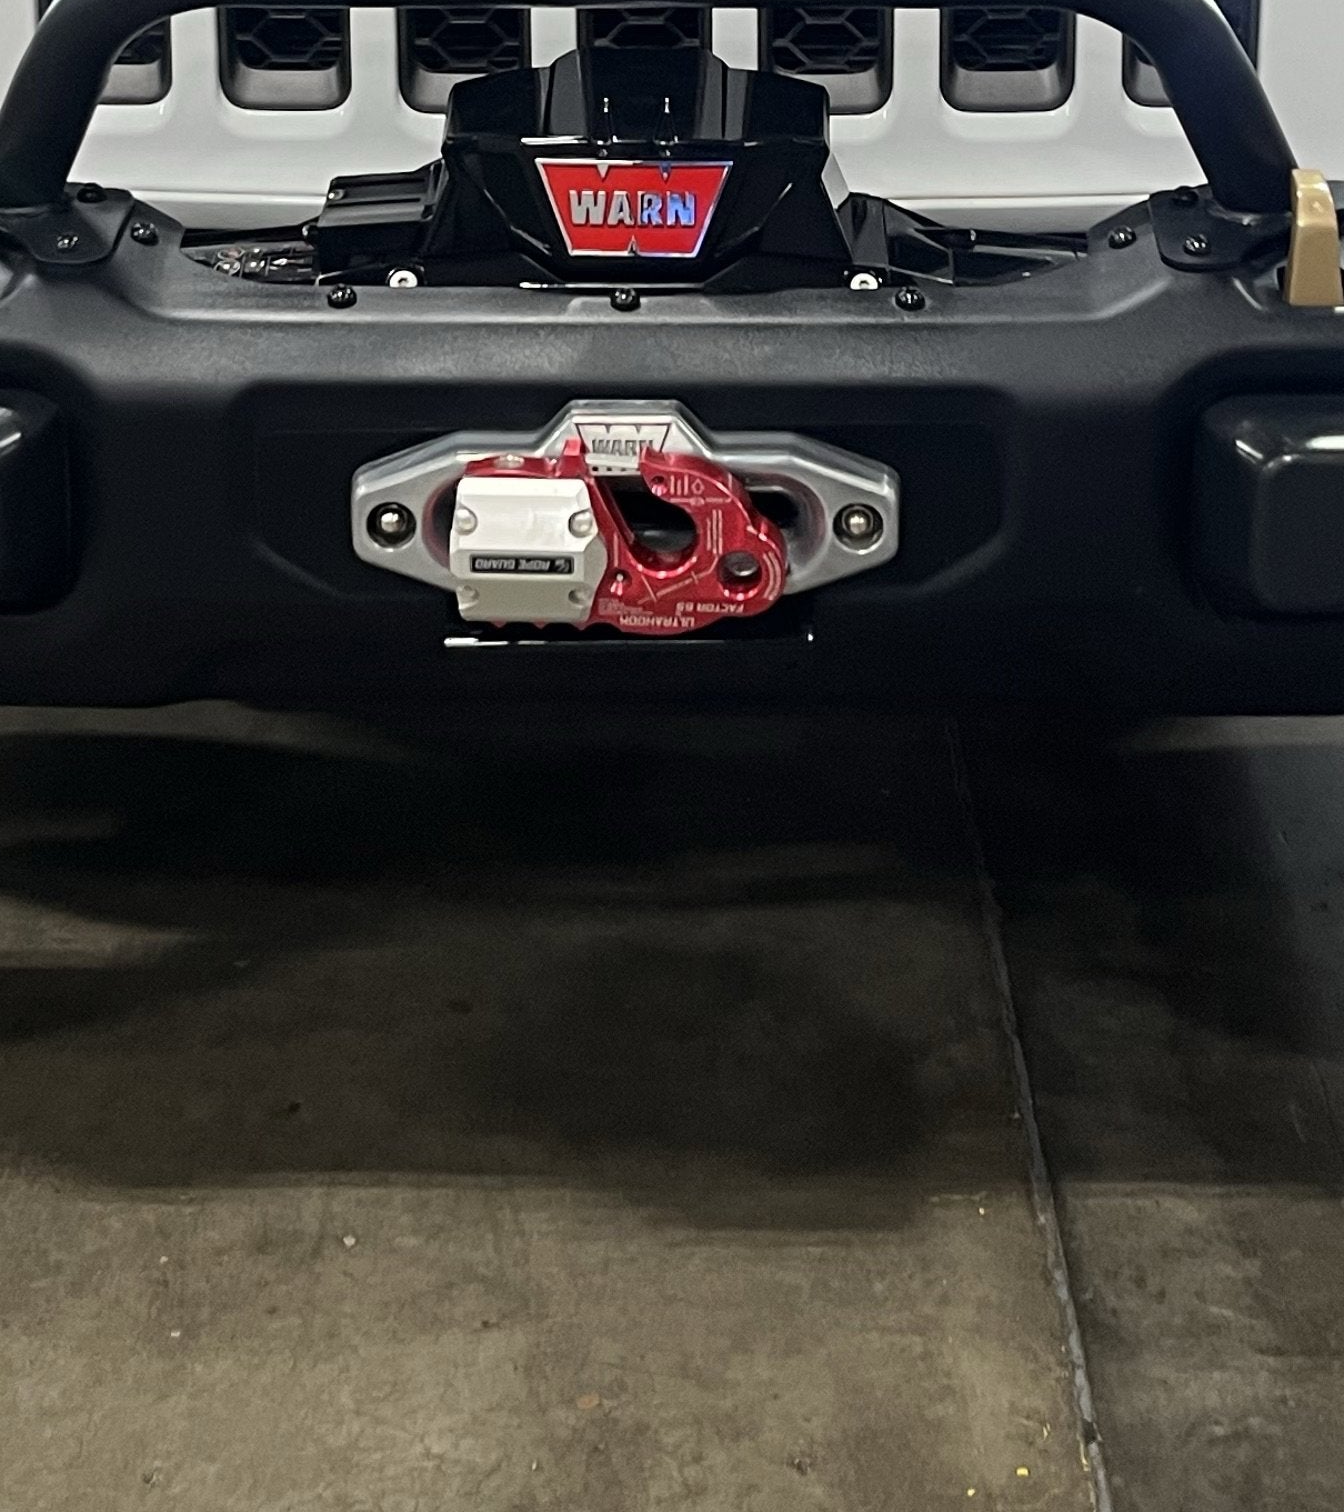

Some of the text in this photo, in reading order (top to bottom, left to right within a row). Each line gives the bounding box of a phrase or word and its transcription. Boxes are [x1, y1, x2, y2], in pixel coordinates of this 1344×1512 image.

[569, 189, 695, 225] WARN
[474, 557, 551, 570] ROPE GUARD
[696, 602, 744, 613] FACTOR
